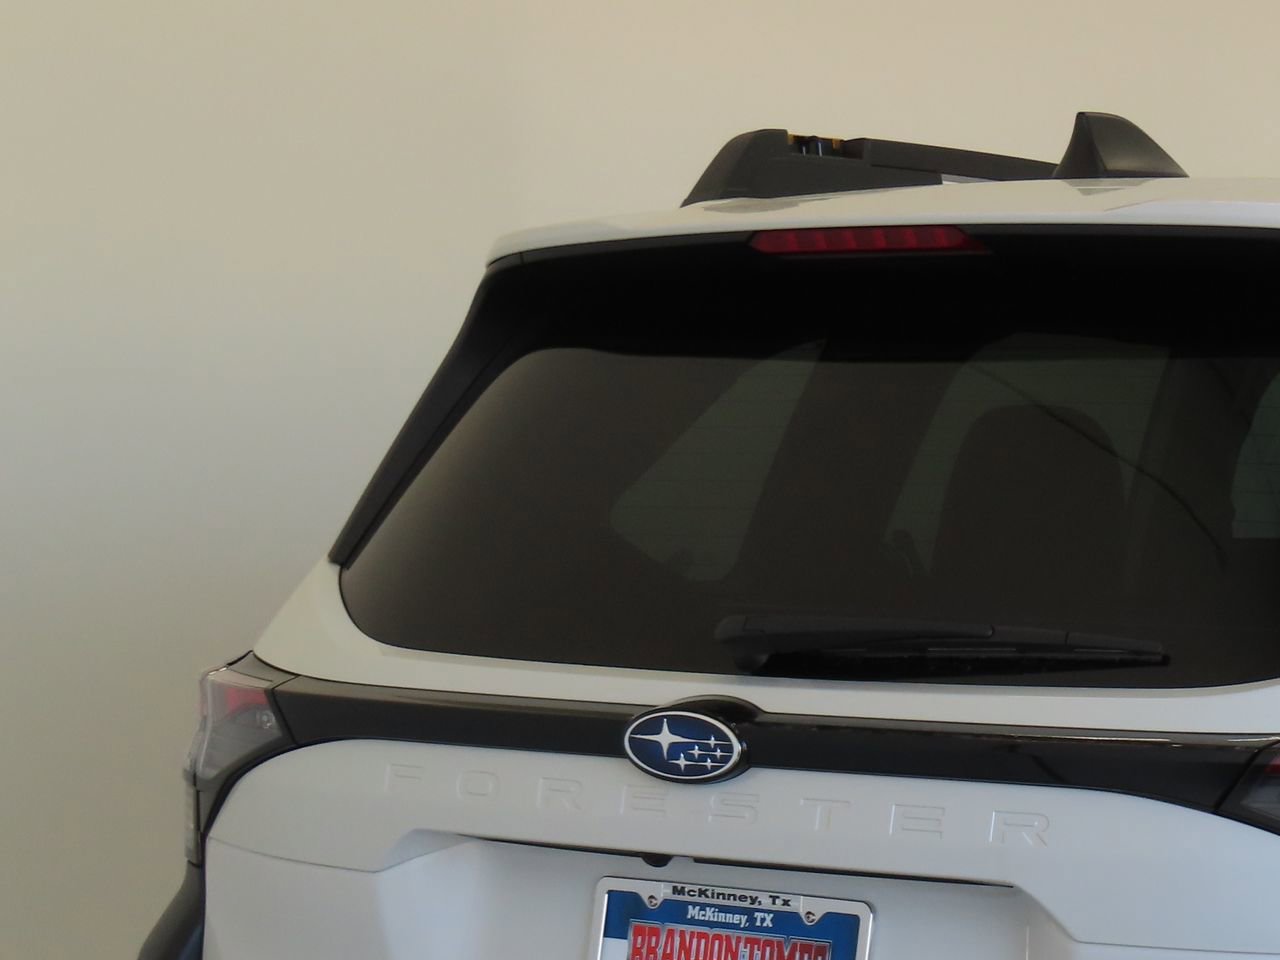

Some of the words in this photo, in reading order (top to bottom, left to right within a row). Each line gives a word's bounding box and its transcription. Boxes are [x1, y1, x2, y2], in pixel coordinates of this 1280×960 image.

[384, 762, 1052, 847] FORESTER
[671, 884, 762, 906] McKinney,
[769, 894, 792, 907] Tx
[686, 904, 749, 928] McKinney,
[753, 911, 775, 928] TX
